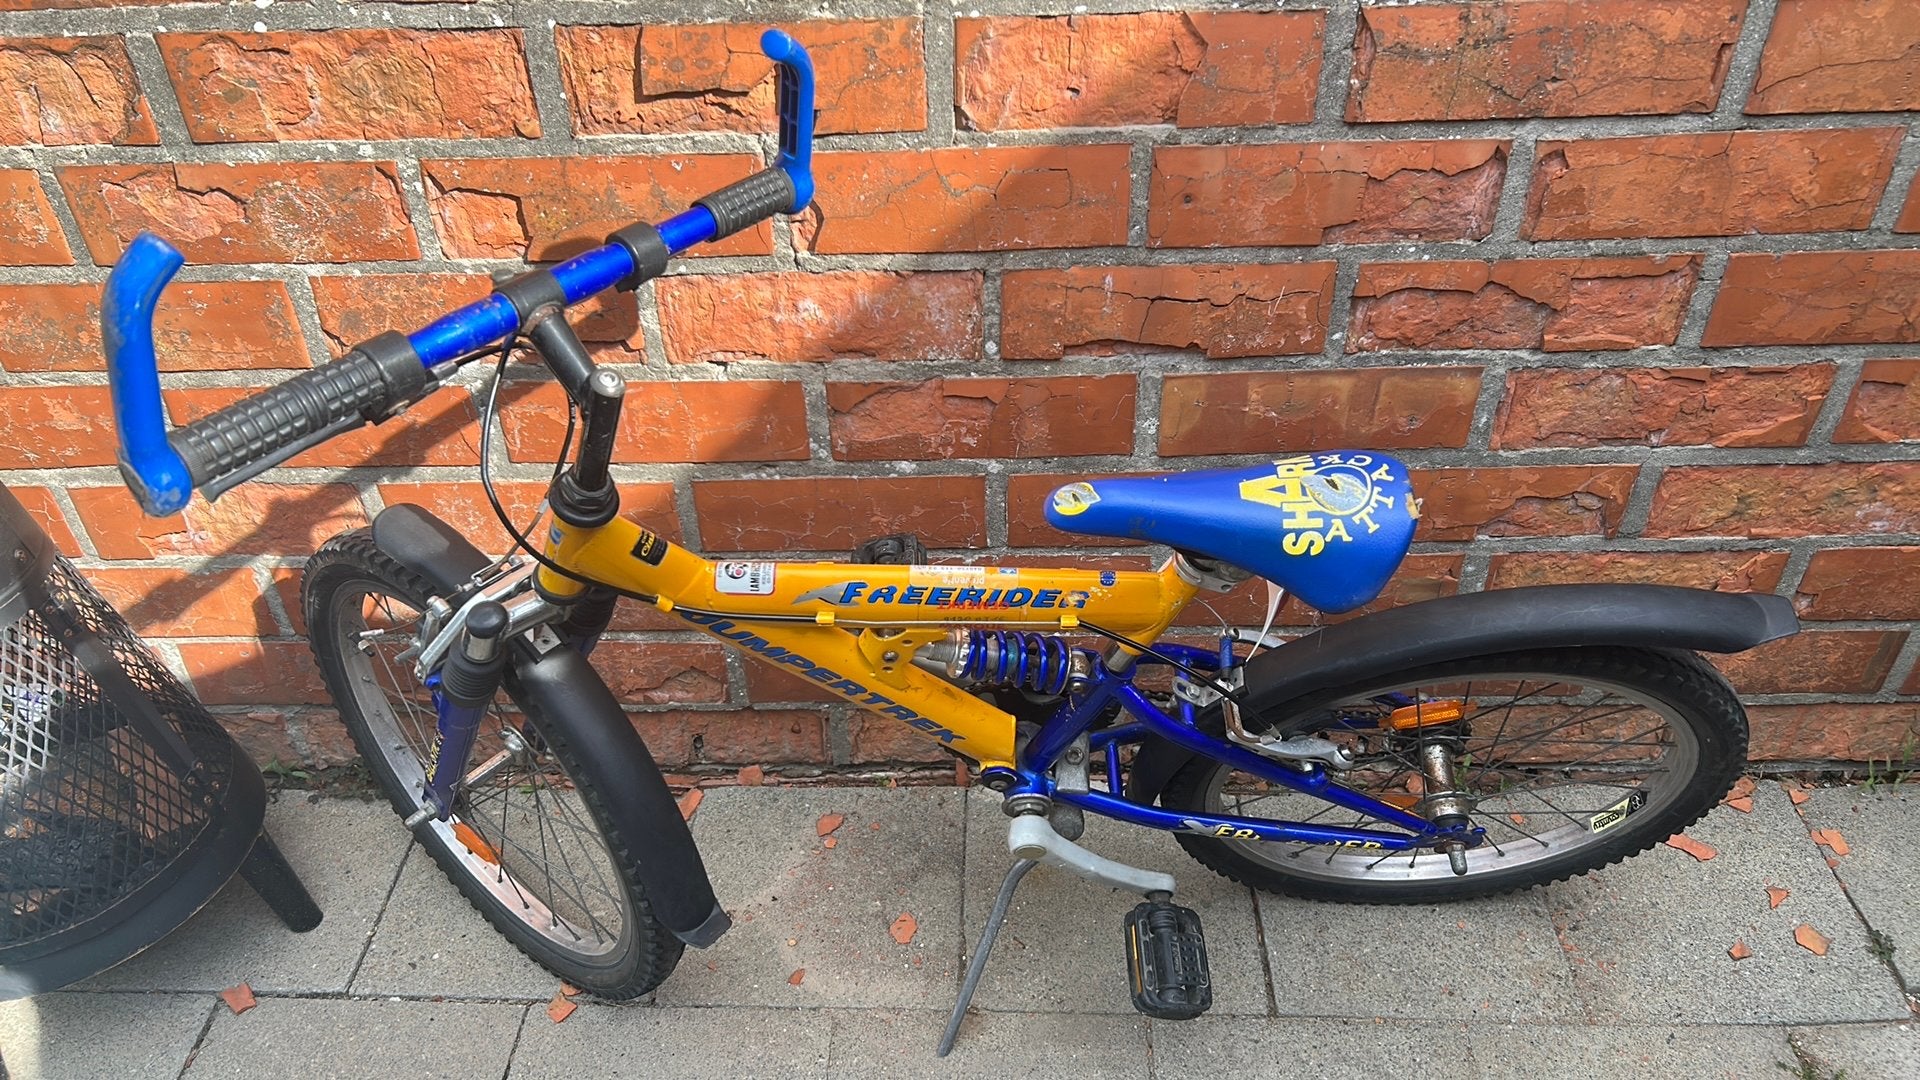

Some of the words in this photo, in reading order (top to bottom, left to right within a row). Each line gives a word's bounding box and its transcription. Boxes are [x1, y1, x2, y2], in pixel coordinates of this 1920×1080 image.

[1240, 454, 1325, 556] SHARK
[1317, 453, 1395, 542] ATTACK
[681, 610, 966, 743] JUMPERTREK
